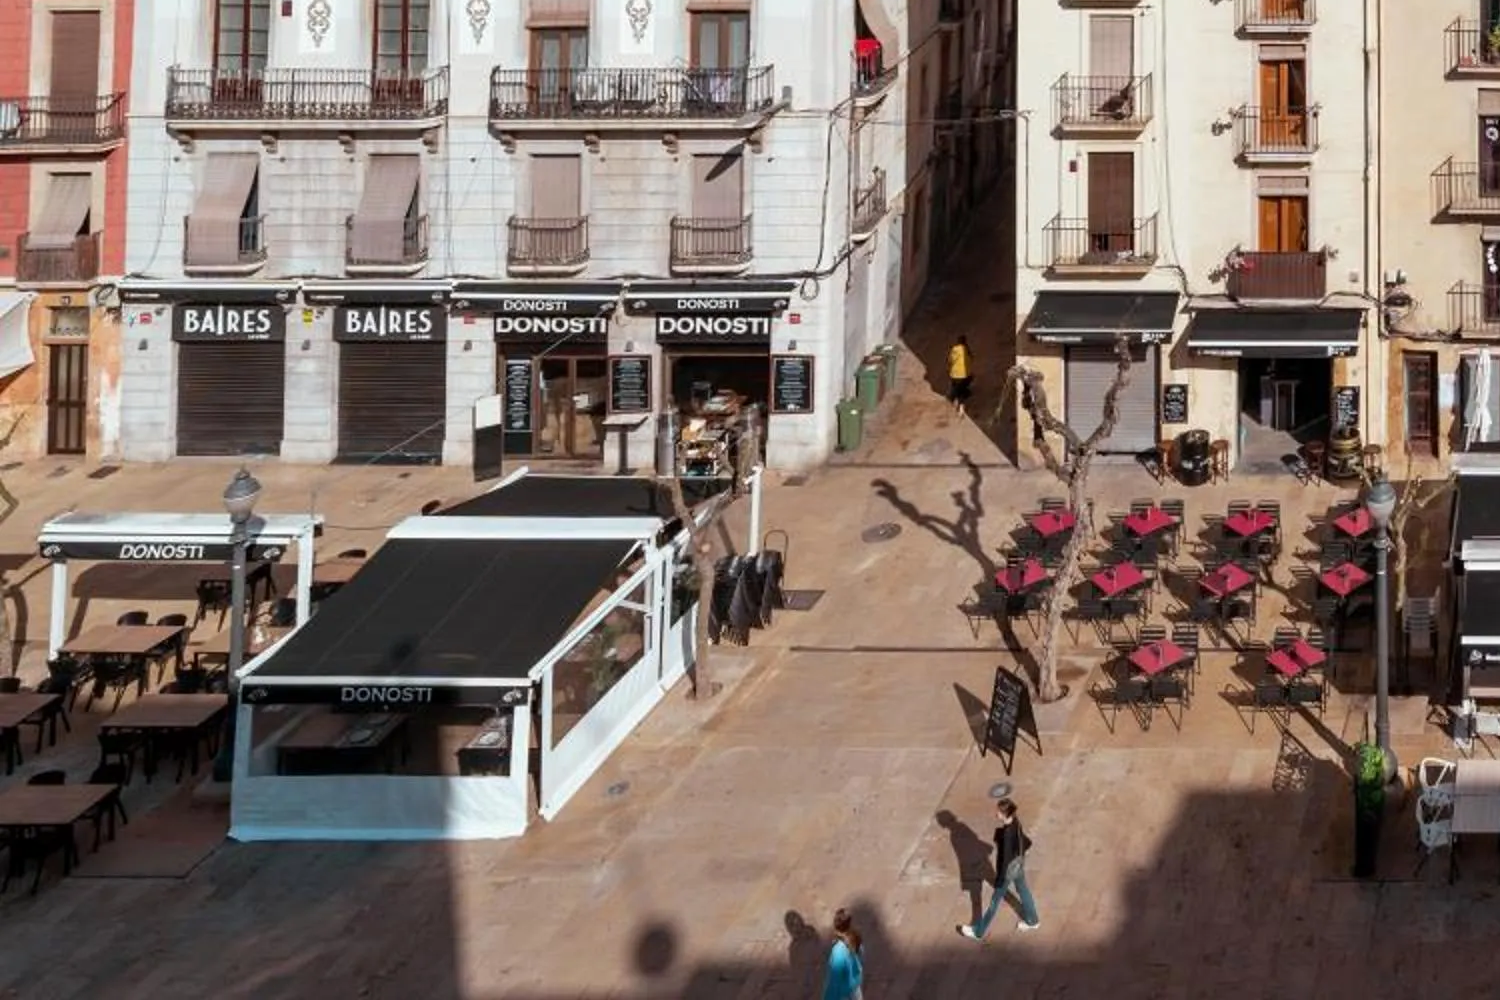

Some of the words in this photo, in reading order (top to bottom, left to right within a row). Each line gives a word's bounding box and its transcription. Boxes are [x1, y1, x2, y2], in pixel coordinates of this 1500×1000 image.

[503, 299, 567, 311] DONOSTI
[677, 298, 739, 309] DONOSTI
[184, 304, 271, 335] BAIRES
[346, 304, 432, 336] BAIRES
[495, 317, 607, 333] DONOSTI
[658, 317, 769, 334] DONOSTI
[120, 544, 204, 559] DONOSTI
[341, 687, 432, 701] DONOSTI
